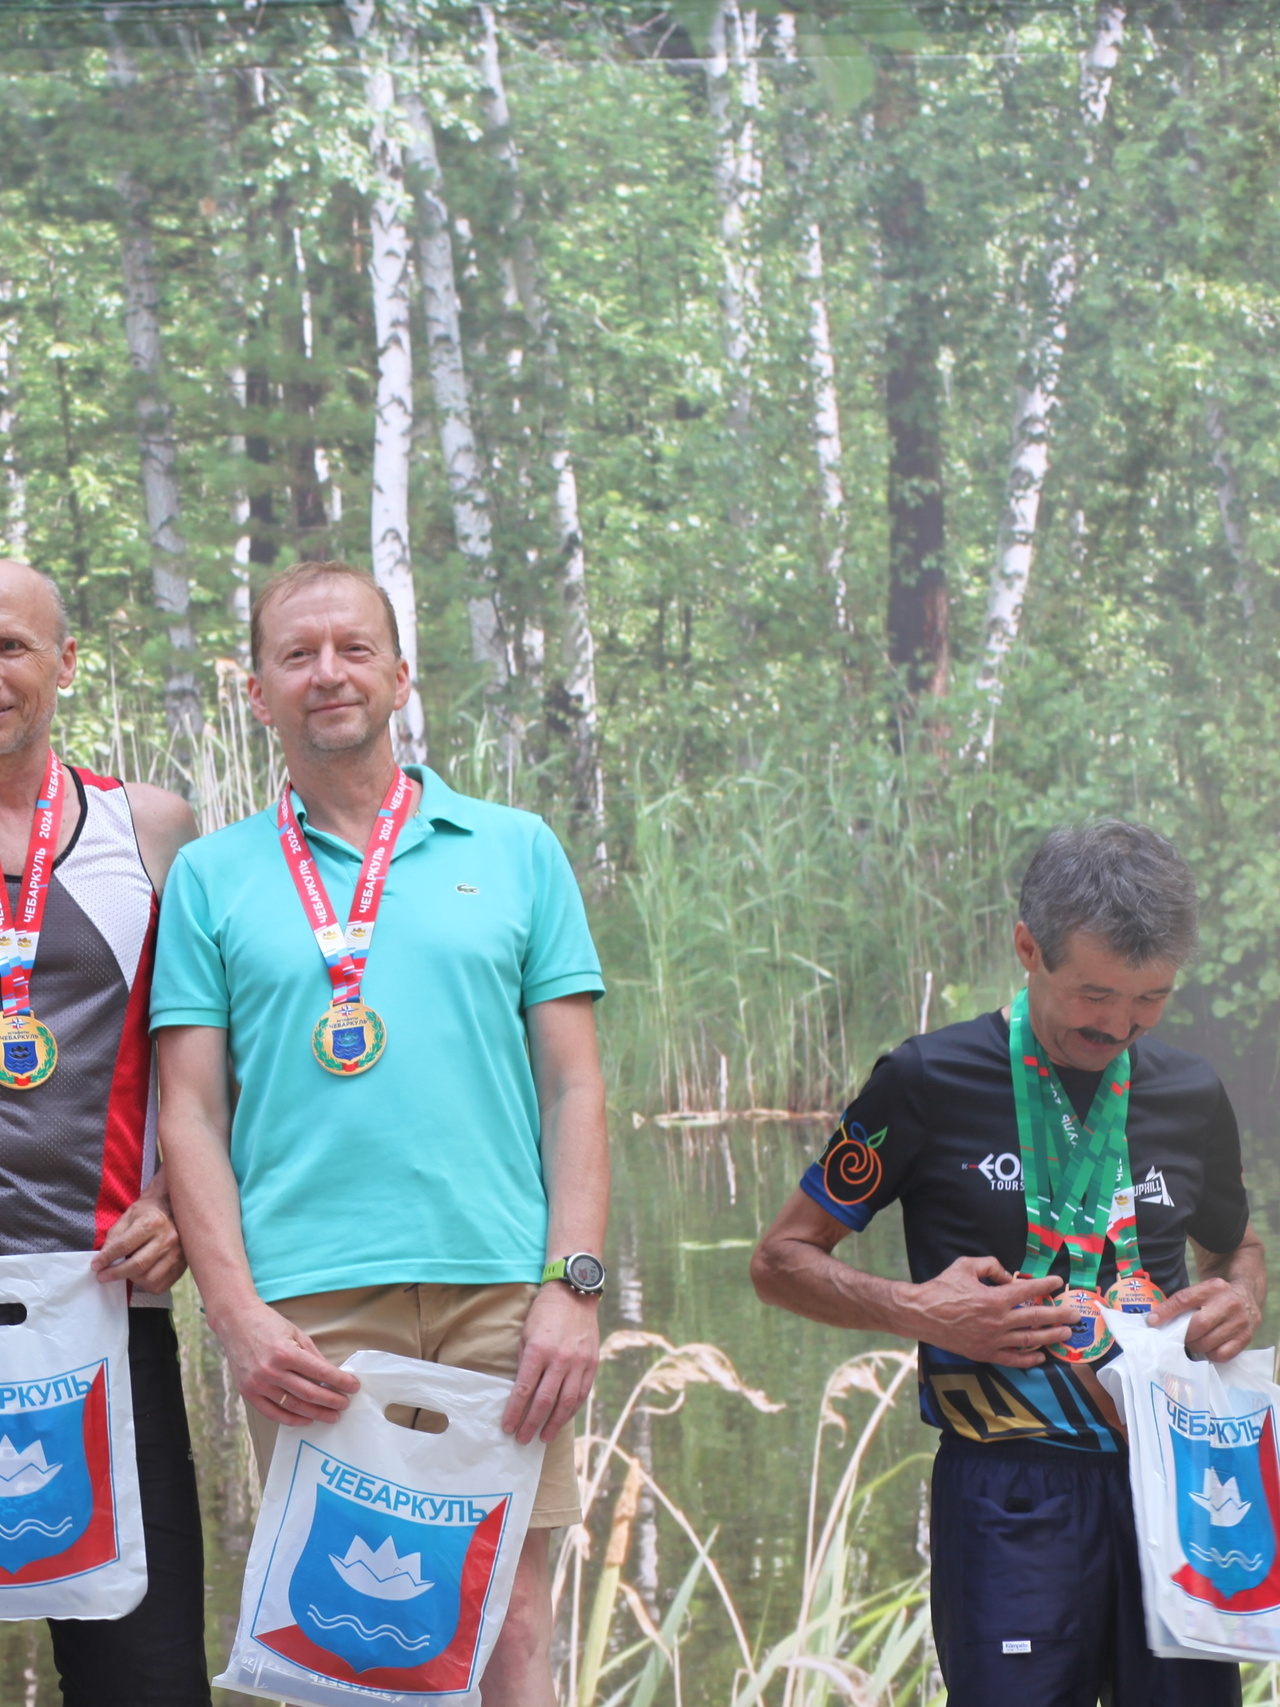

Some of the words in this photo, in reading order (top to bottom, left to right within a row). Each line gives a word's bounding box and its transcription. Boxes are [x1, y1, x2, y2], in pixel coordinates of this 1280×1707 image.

[24, 848, 46, 923] ЧЕБАРКУЛЬ
[39, 811, 54, 839] 2024
[286, 827, 302, 855] 2024
[358, 847, 385, 913] ЧЕБАРКУЛЬ
[379, 818, 395, 841] 2024
[298, 859, 327, 923] ЧЕБАРКУЛЬ
[990, 1180, 1026, 1191] TOURS
[1167, 1400, 1263, 1444] ЧЕБРКУЛЬ
[321, 1459, 488, 1523] ЧЕБАРКУЛЬ
